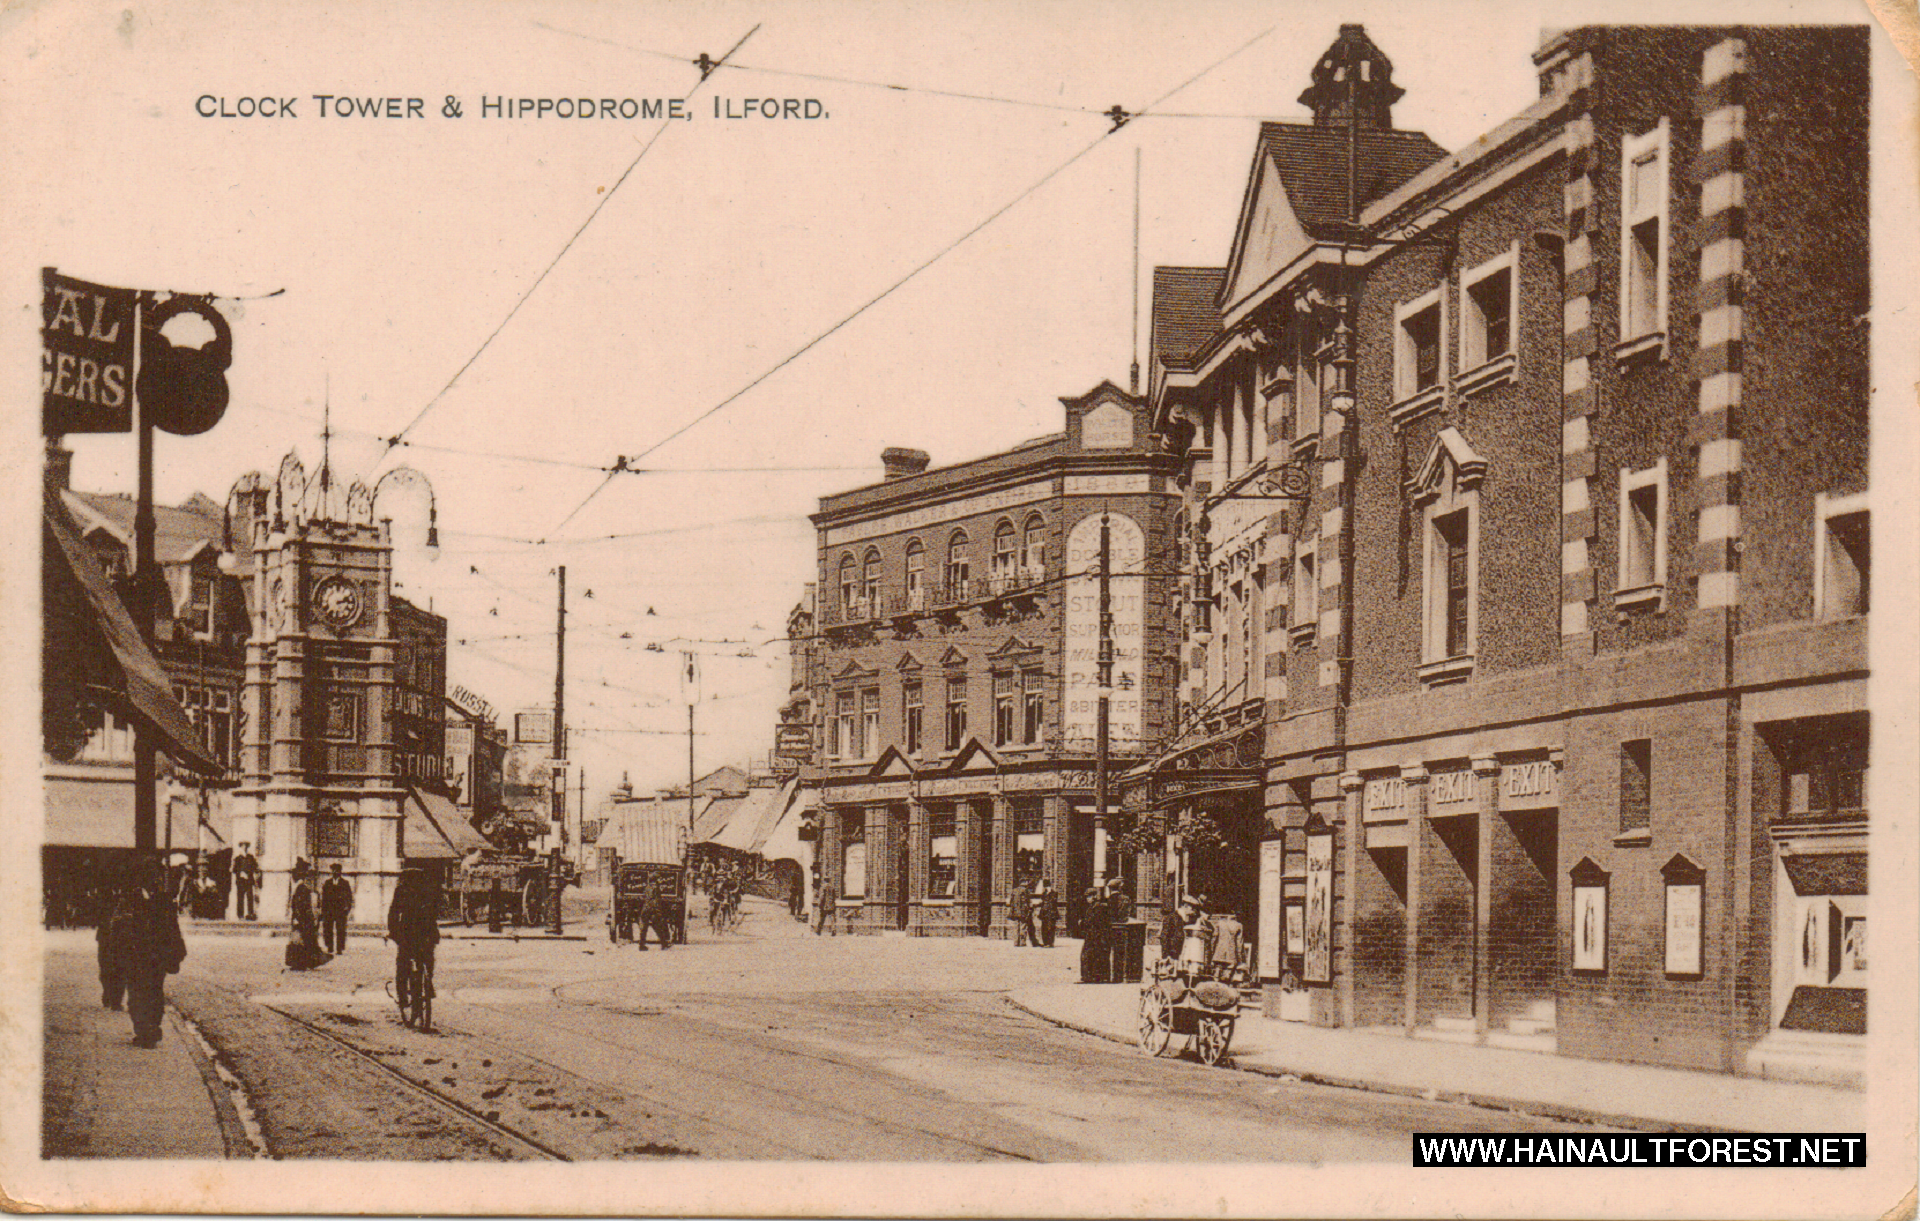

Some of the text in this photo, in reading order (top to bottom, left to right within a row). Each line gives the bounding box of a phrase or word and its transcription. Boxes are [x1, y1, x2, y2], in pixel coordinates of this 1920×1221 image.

[1071, 548, 1138, 562] DOBLE
[1070, 595, 1138, 612] STUT
[1069, 623, 1139, 637] SUPRIOR
[1435, 771, 1475, 805] EXIT
[1509, 762, 1553, 797] EXIT
[1369, 779, 1406, 812] EXIT
